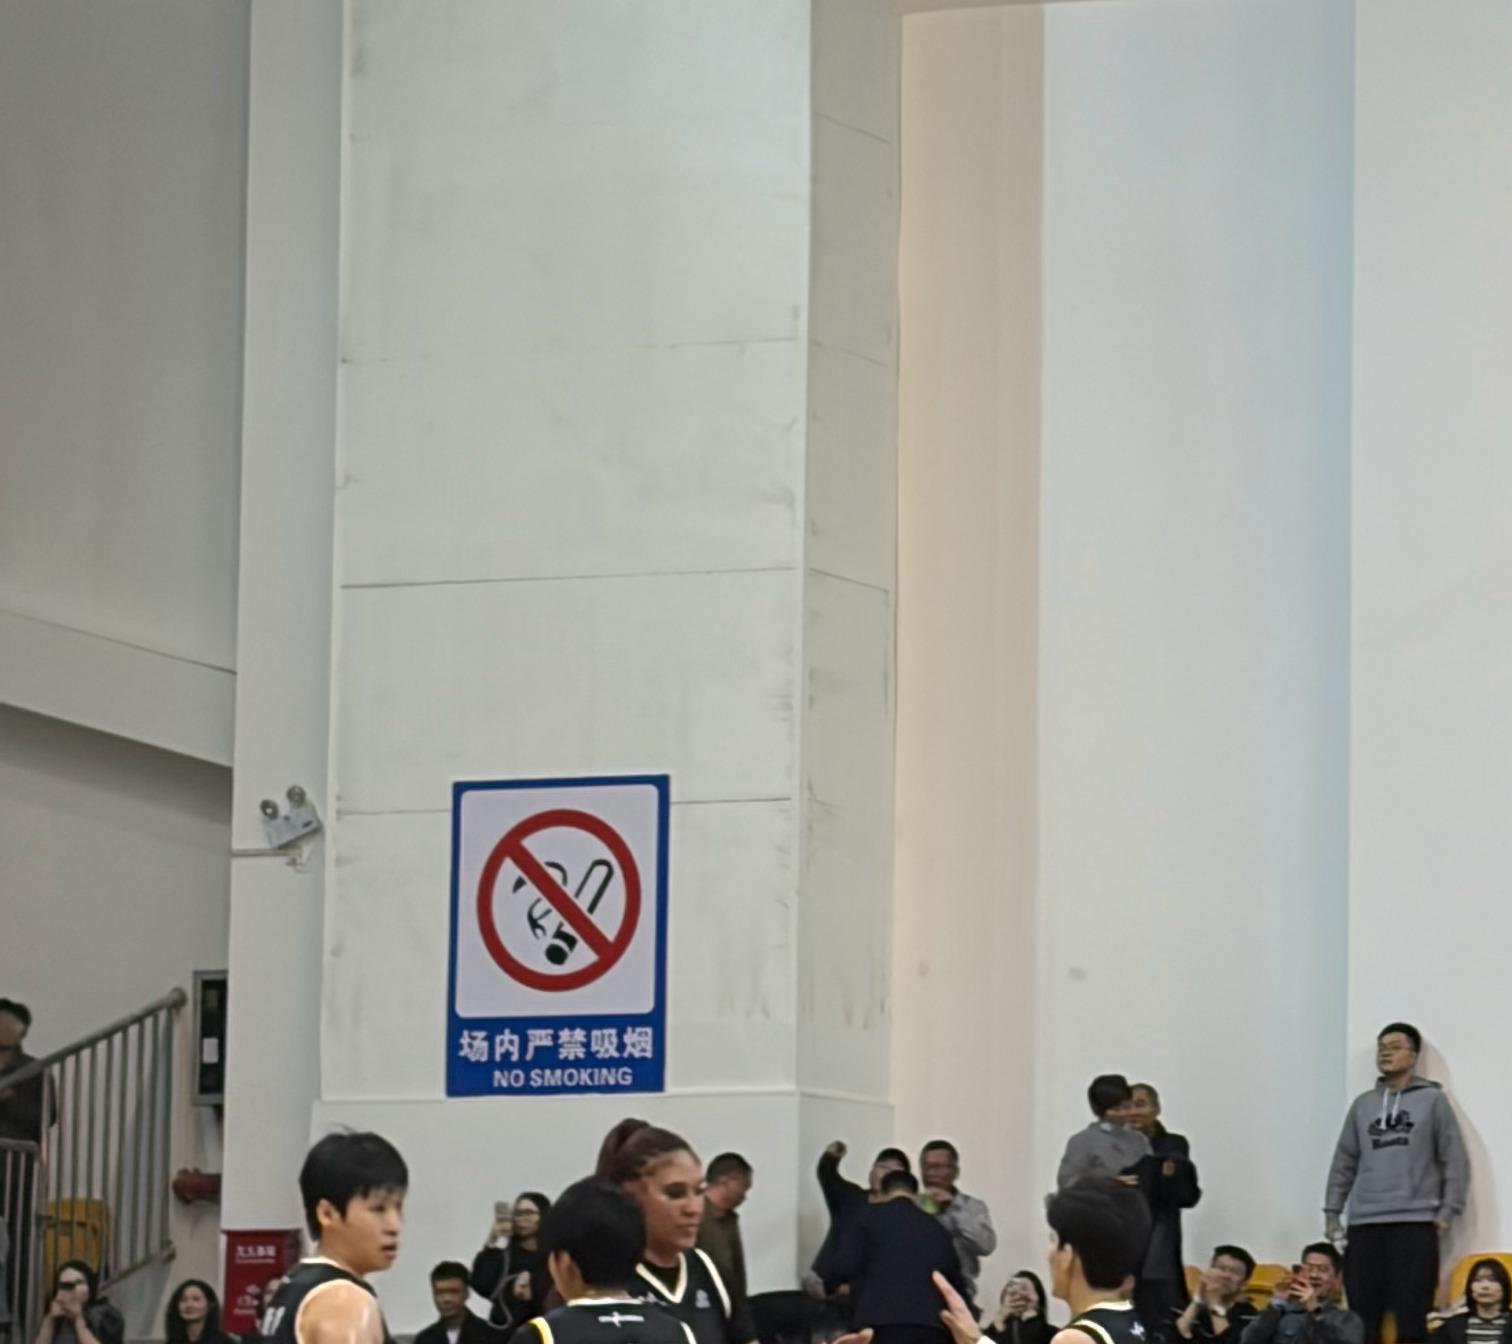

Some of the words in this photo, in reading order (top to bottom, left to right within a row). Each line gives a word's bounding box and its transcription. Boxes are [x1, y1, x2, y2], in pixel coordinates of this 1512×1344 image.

[459, 1026, 654, 1063] 场内严禁吸烟
[493, 1069, 526, 1089] NO
[530, 1066, 633, 1088] SMOKING
